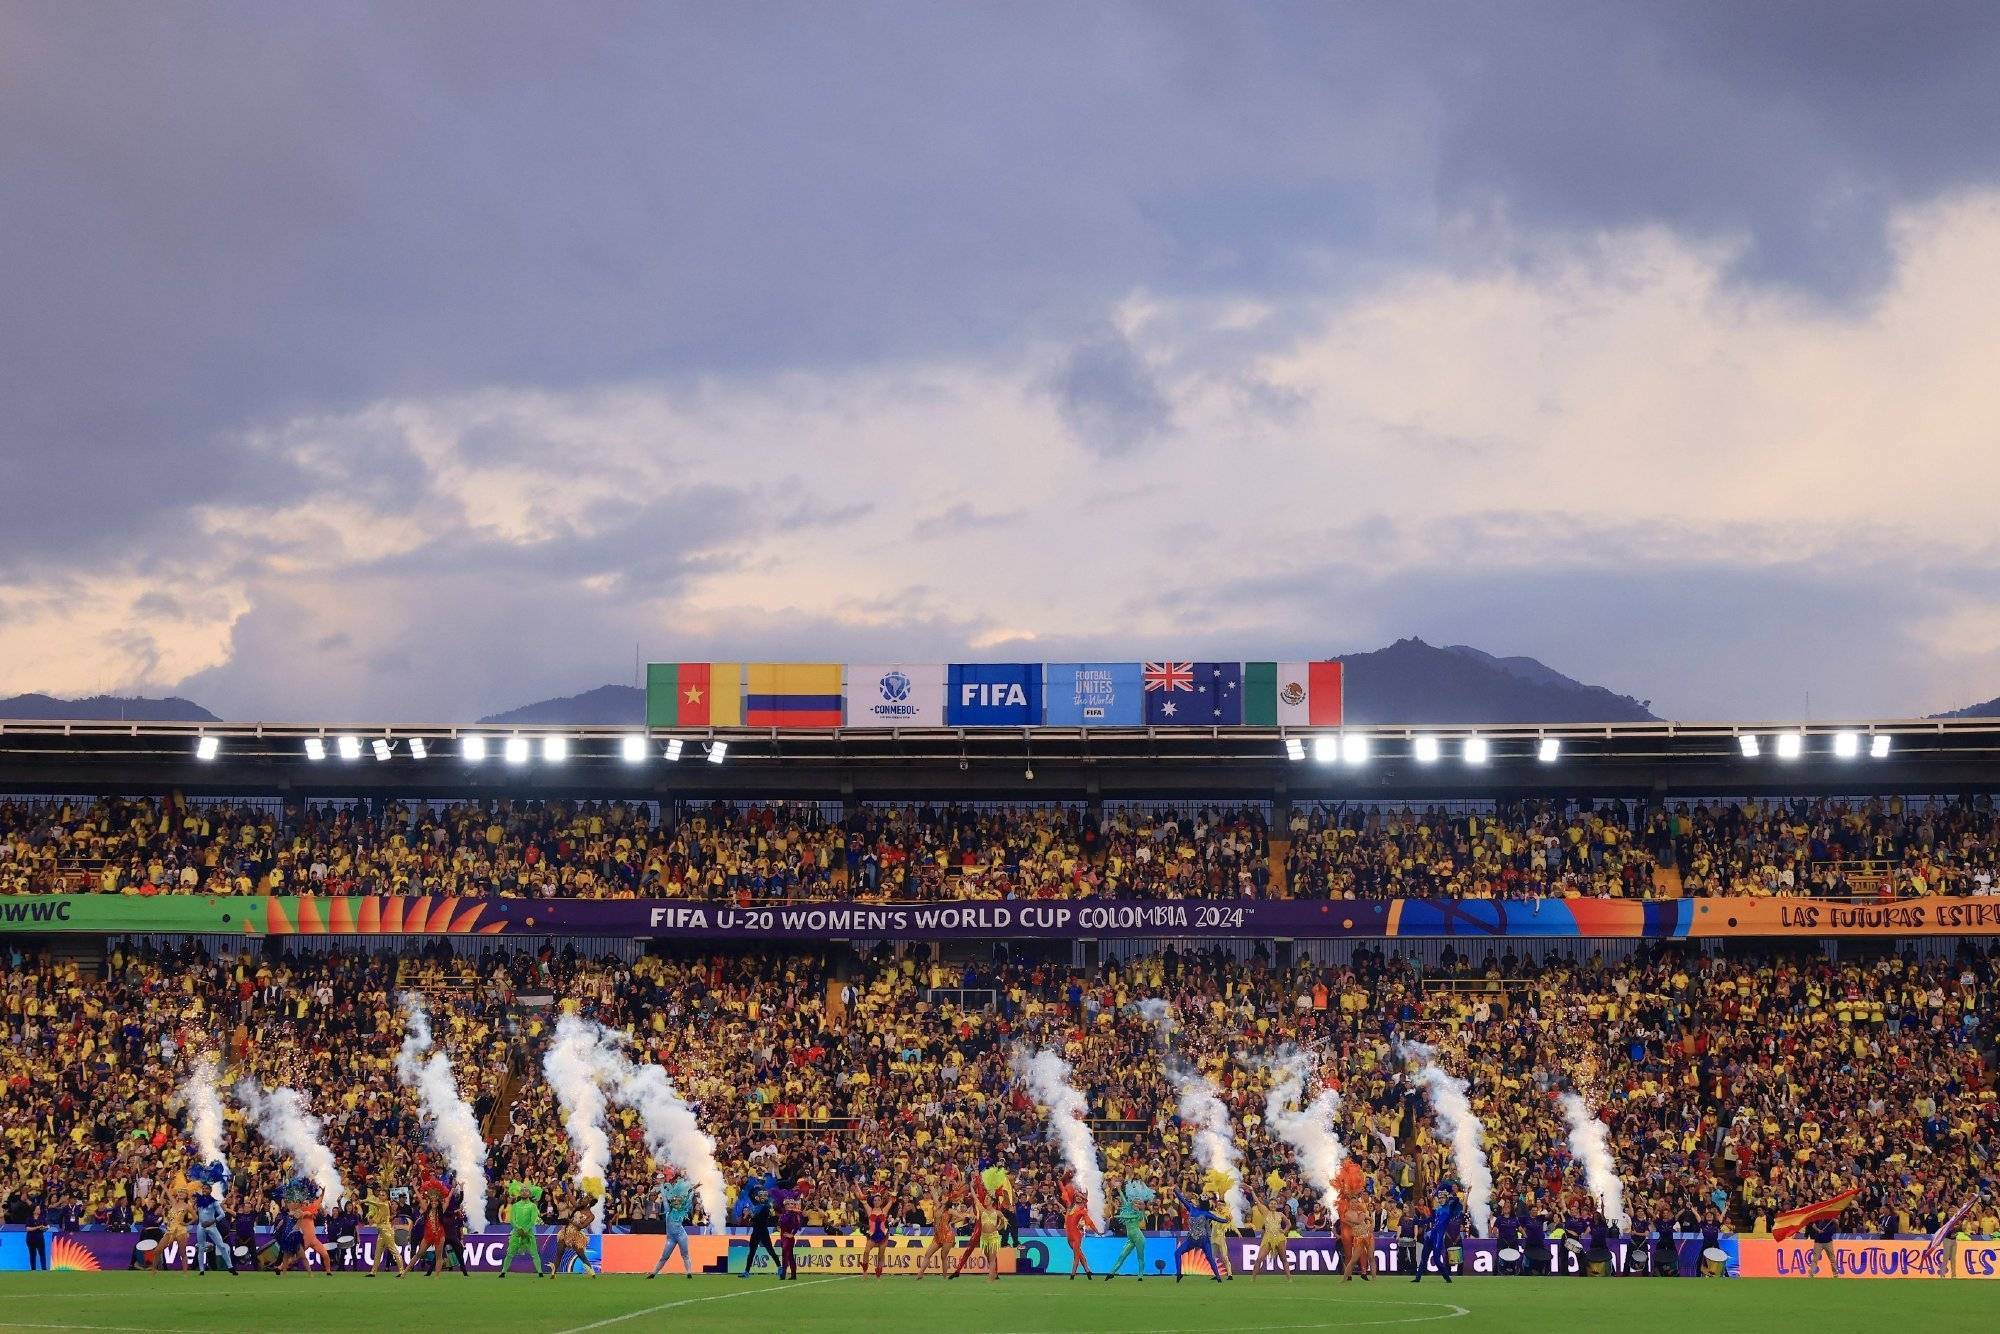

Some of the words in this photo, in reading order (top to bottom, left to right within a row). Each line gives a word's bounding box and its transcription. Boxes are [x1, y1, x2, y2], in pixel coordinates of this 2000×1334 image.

[1075, 670, 1112, 680] FOOTBALL
[962, 683, 1027, 706] FIFA
[1075, 681, 1112, 693] UNITES
[1088, 694, 1115, 706] World
[0, 902, 72, 922] WWC
[650, 907, 708, 928] FIFA
[716, 910, 773, 930] U-20
[781, 910, 907, 930] WOMEN’S
[914, 908, 1011, 929] WORLD
[1020, 907, 1071, 928] CUP
[1078, 906, 1188, 929] COLOMBIA
[1782, 906, 1820, 928] LAS
[1830, 905, 1926, 928] FUTURAS
[1473, 1250, 1494, 1273] a
